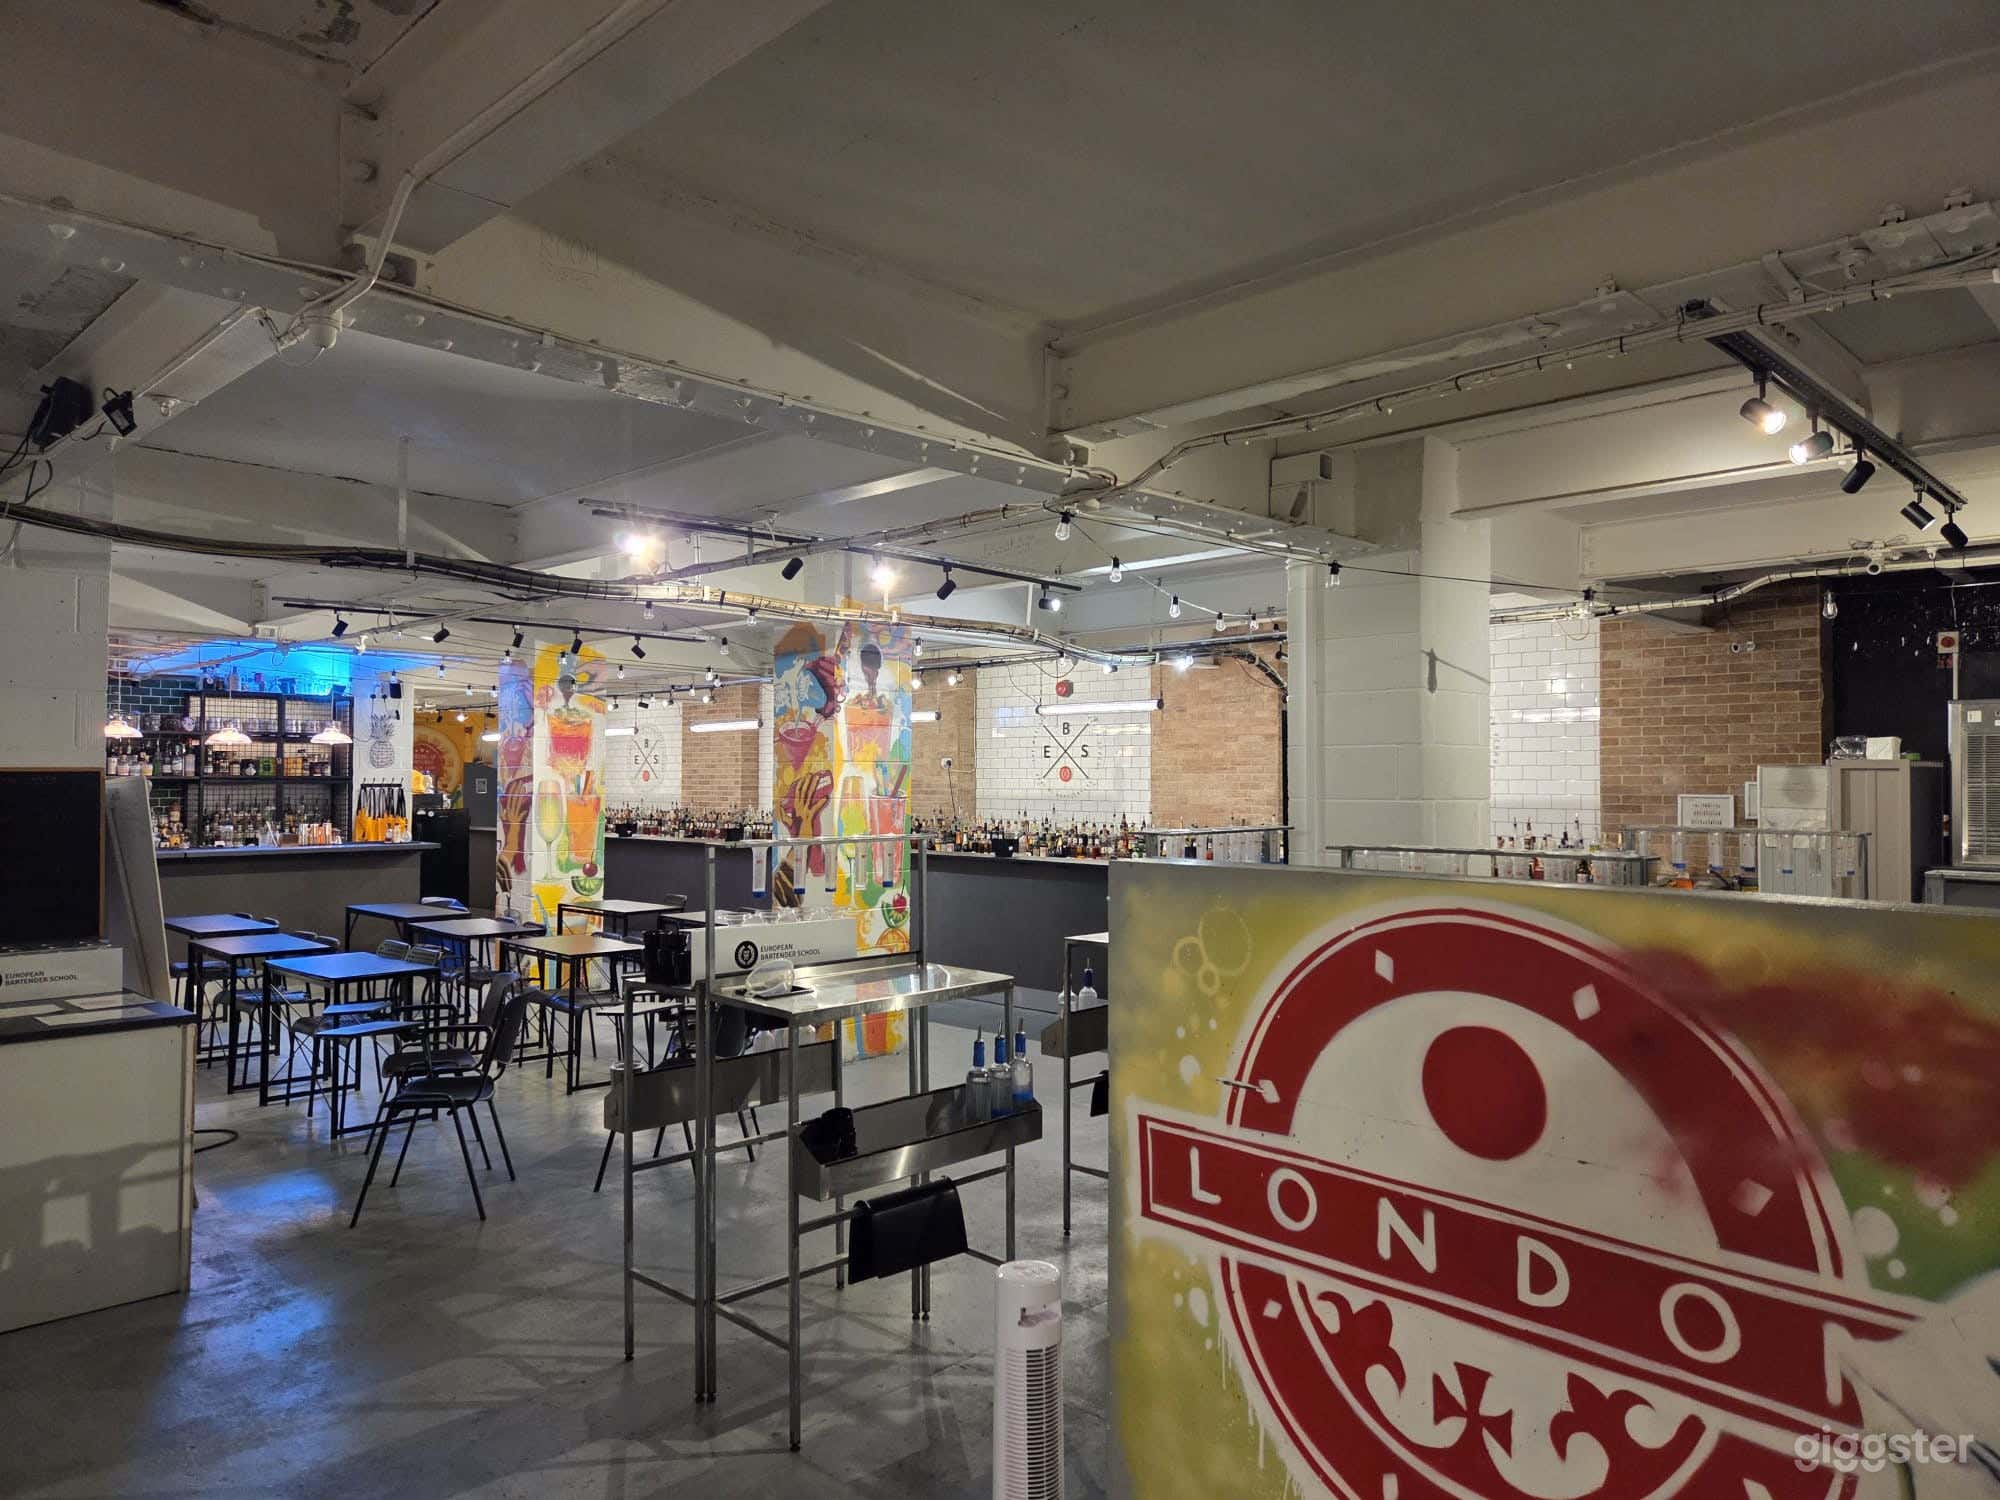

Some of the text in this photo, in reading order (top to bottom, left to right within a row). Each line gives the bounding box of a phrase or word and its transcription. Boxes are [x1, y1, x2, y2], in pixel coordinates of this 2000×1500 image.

[1062, 722, 1070, 736] B
[1043, 744, 1089, 758] E S
[760, 943, 794, 953] EUROPEAN
[760, 948, 821, 961] BARTENDER SCHOOL
[5, 971, 45, 980] EUROPEAN
[5, 974, 78, 987] BARTENDER SCHOOL
